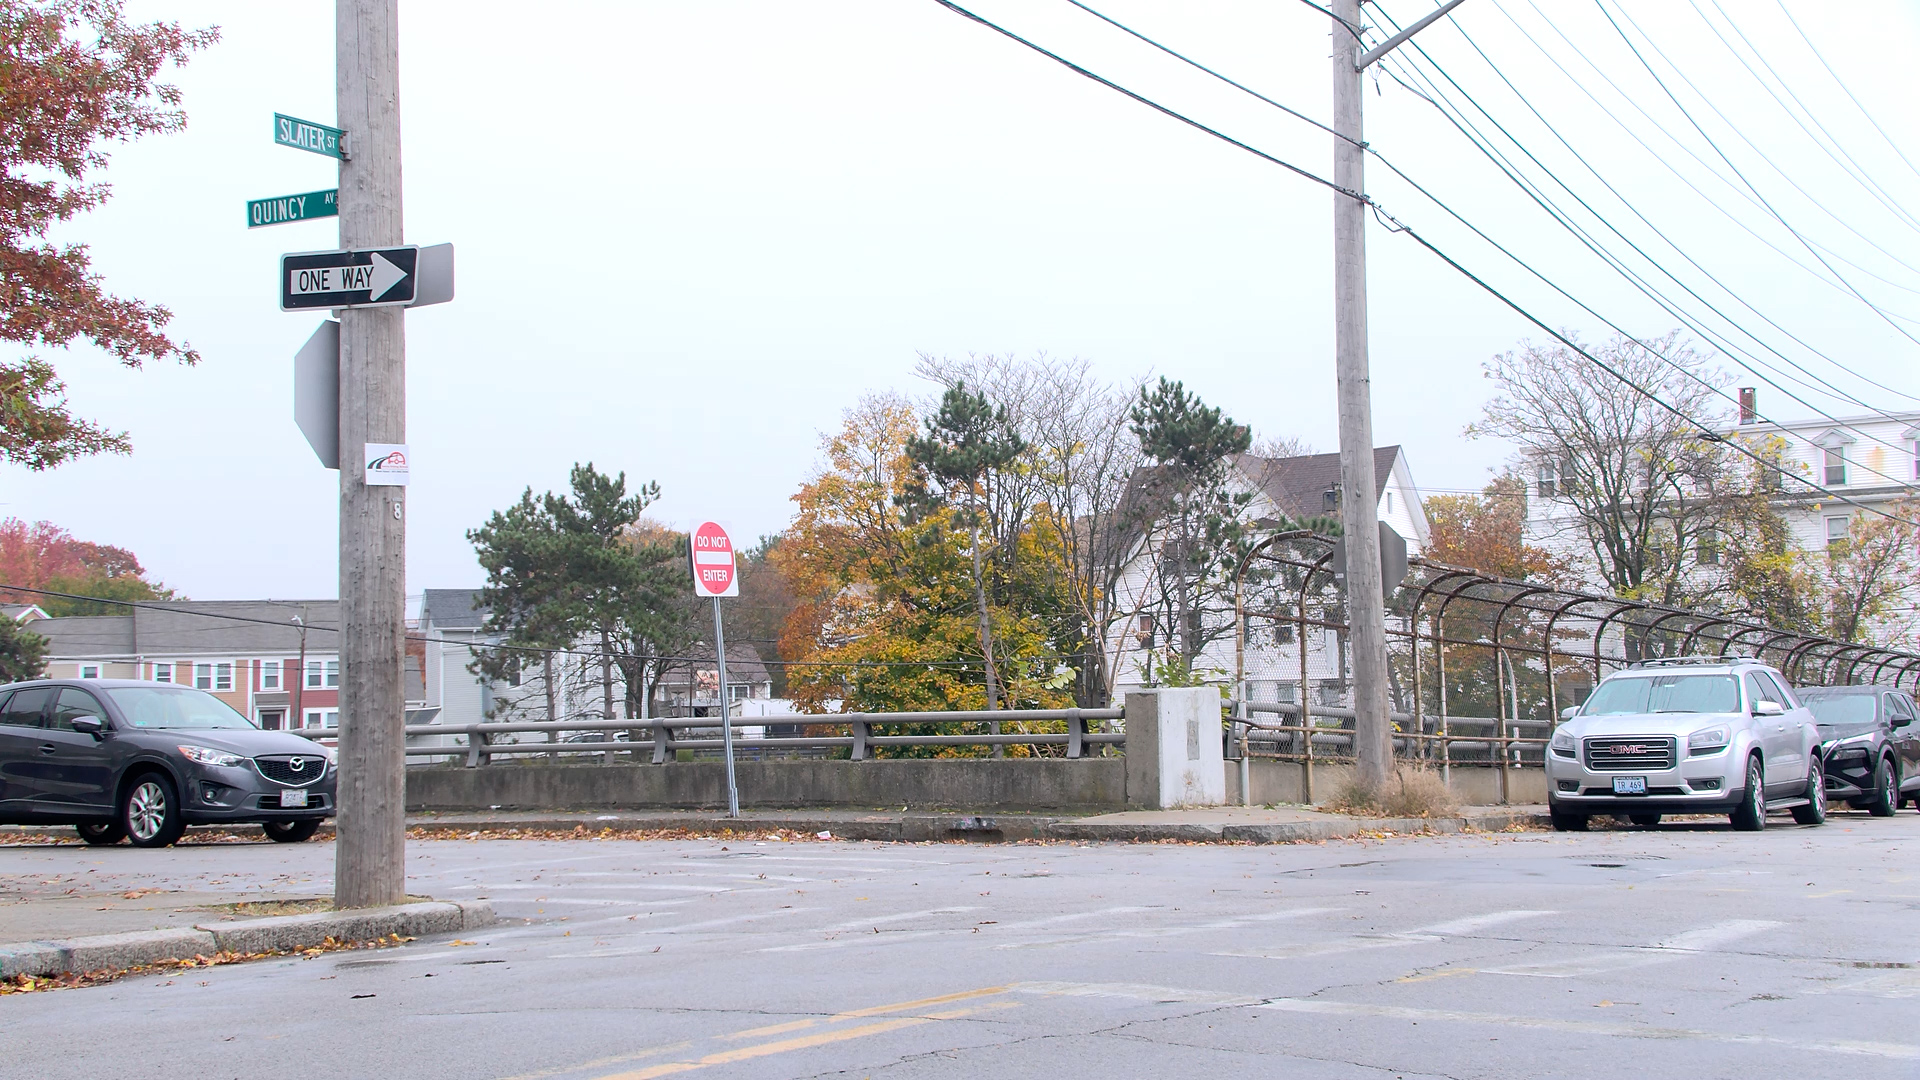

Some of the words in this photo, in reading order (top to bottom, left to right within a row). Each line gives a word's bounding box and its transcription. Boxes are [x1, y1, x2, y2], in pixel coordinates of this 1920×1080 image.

[280, 119, 325, 151] SLATER
[327, 136, 335, 148] ST
[253, 196, 306, 224] QUINCY
[299, 269, 330, 292] ONE
[341, 266, 374, 289] WAY
[394, 503, 402, 520] 8
[697, 536, 709, 547] DO
[711, 536, 727, 548] NOT
[703, 569, 728, 582] ENTER
[1609, 745, 1647, 754] GMC
